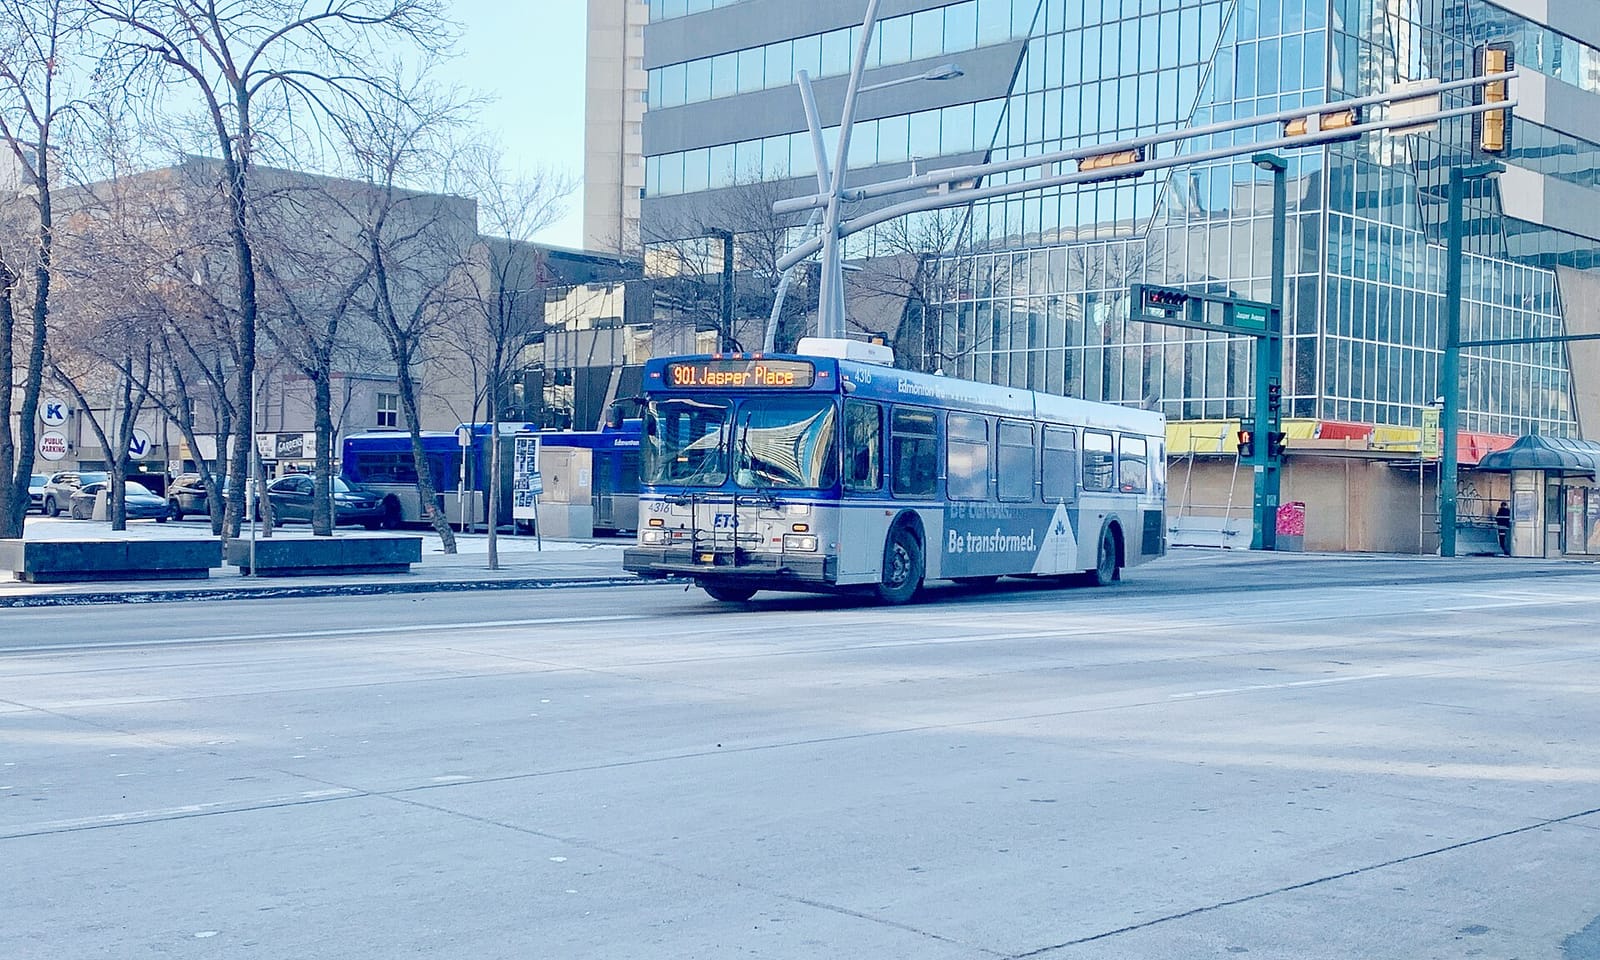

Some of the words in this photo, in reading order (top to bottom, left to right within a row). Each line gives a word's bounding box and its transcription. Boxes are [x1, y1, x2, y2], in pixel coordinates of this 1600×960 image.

[674, 366, 696, 385] 901
[699, 366, 751, 387] Jasper
[755, 366, 794, 386] Place
[854, 367, 872, 384] 4316
[897, 377, 935, 397] Edmonton
[47, 403, 64, 420] K
[41, 445, 66, 453] PARKING
[44, 437, 63, 445] PUBLIC
[648, 502, 670, 514] 4316
[715, 513, 740, 529] ETS
[948, 529, 964, 553] Be
[967, 527, 1037, 553] transformed.
